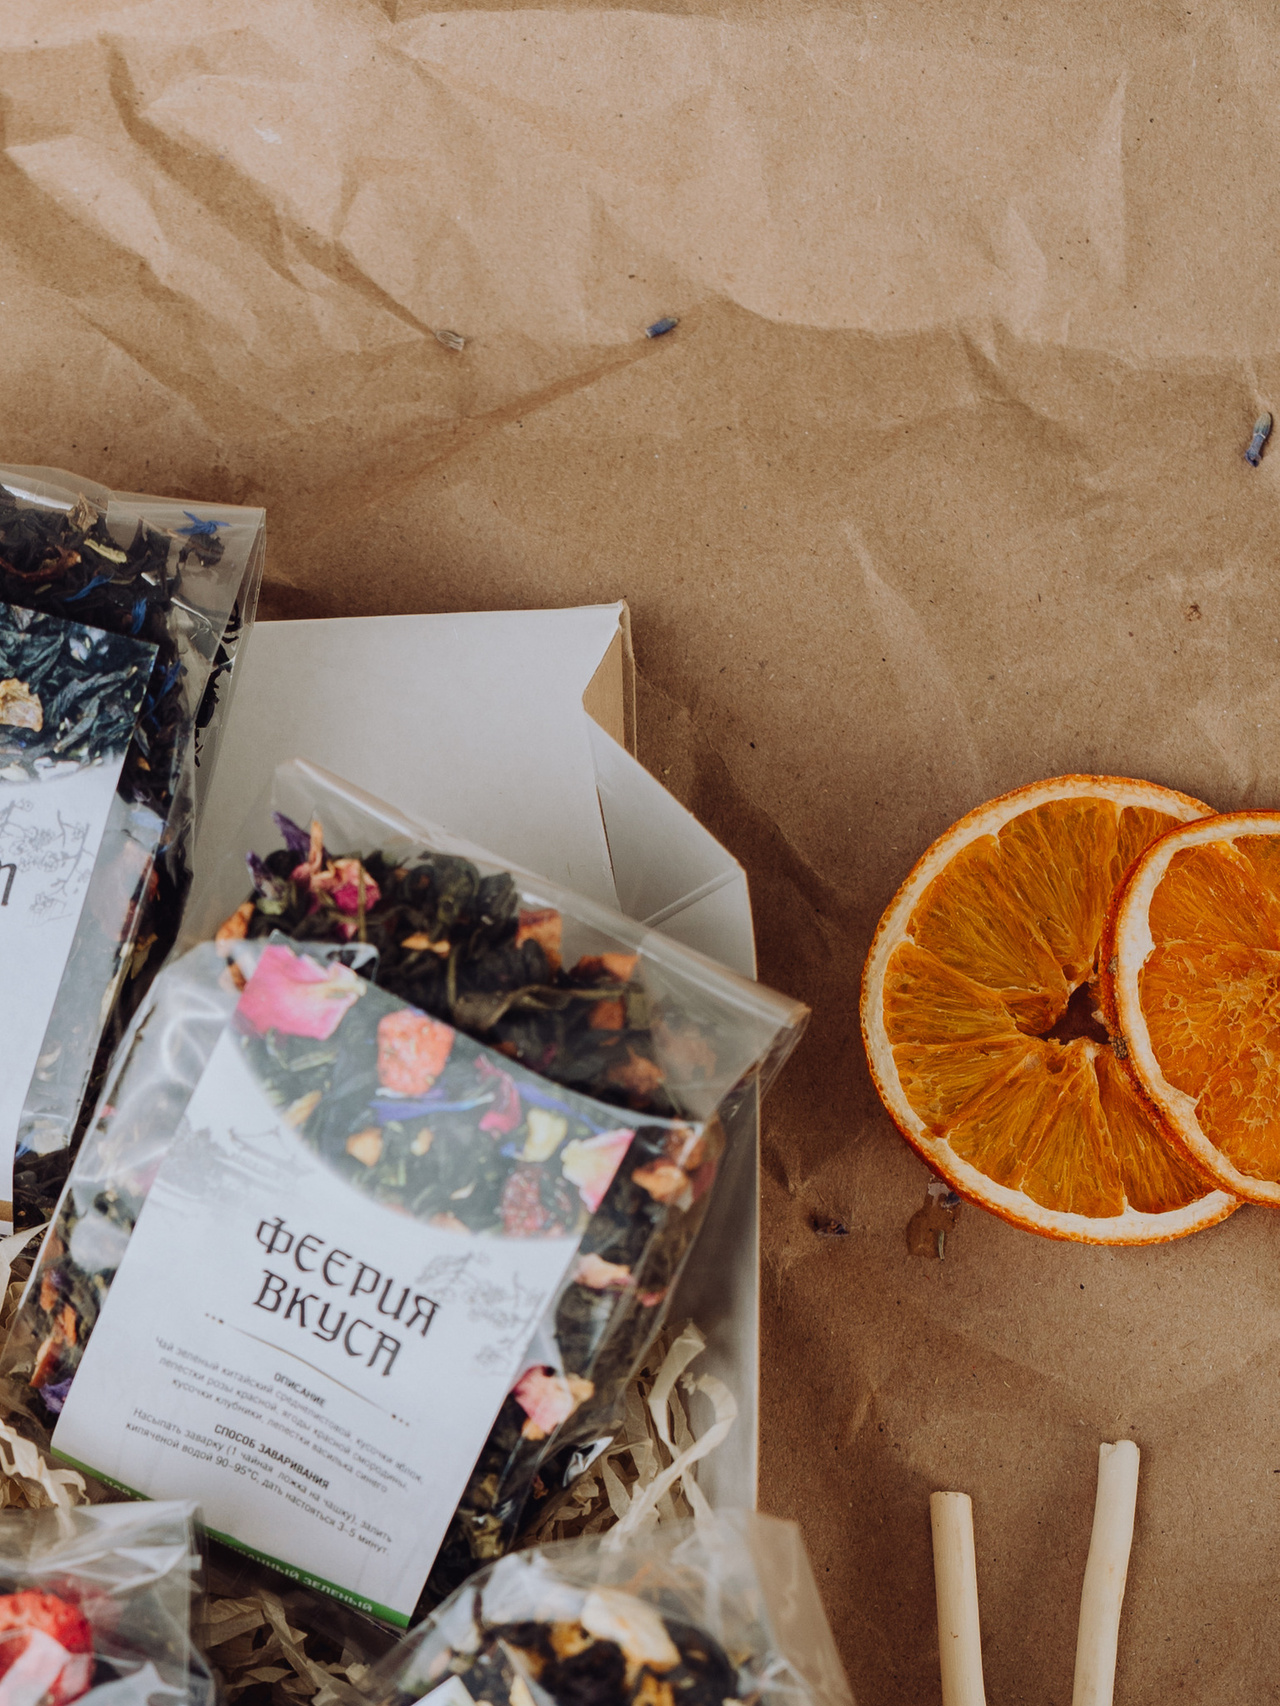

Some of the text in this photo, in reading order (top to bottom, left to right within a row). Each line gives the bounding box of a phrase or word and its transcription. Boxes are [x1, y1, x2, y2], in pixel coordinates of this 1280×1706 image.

[255, 1216, 440, 1337] ФЕЕРИЯ
[252, 1269, 402, 1377] ВКУСА
[272, 1372, 327, 1408] ОПИСАНИЕ
[124, 1421, 182, 1450] кипяченой
[179, 1444, 216, 1463] водой
[260, 1478, 285, 1497] дать
[132, 1407, 184, 1435] Насыпать
[183, 1429, 226, 1453] заварку
[237, 1451, 276, 1474] чайная
[276, 1471, 310, 1495] ложка
[308, 1489, 323, 1503] на
[213, 1423, 331, 1490] СПОСОБ ЗАВАРИВАНИЯ
